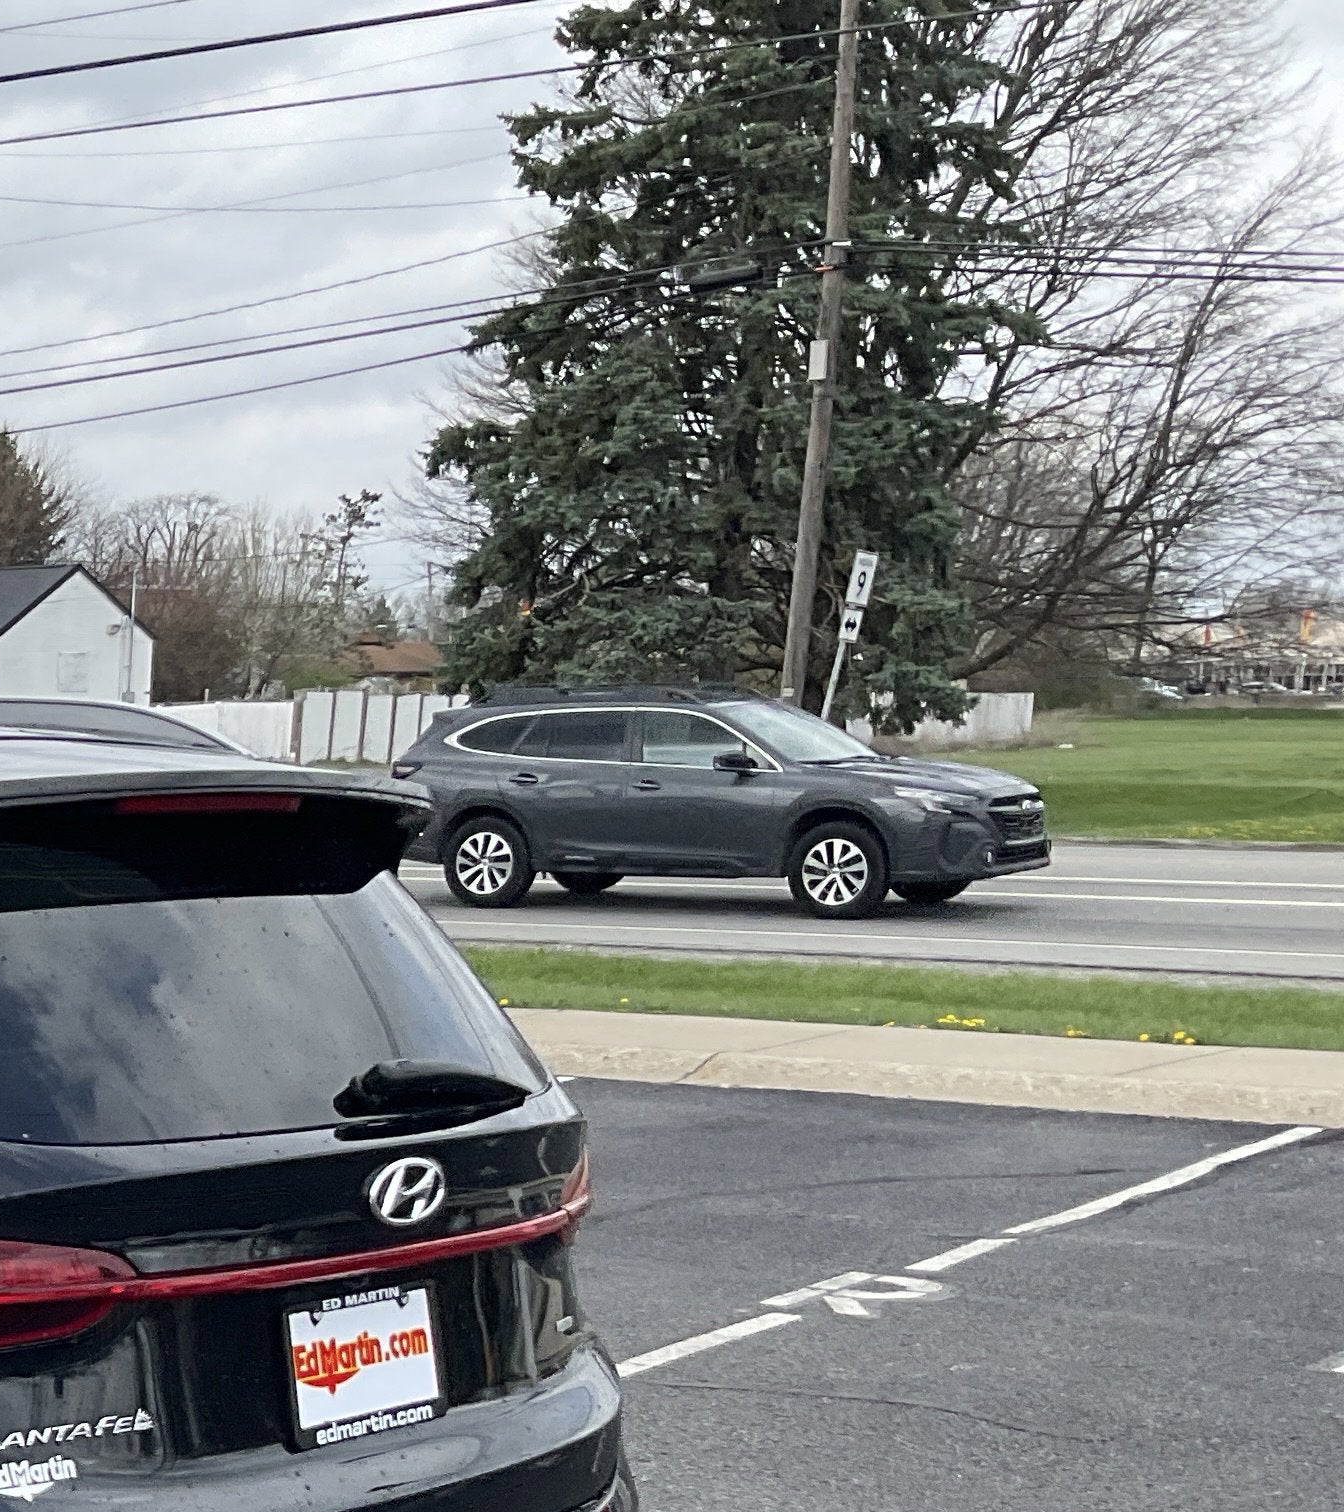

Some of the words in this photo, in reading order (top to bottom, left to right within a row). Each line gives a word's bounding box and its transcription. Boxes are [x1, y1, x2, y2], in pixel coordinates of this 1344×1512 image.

[856, 570, 867, 598] 9
[322, 1297, 342, 1311] ED
[344, 1286, 401, 1306] MARTIN
[291, 1327, 430, 1380] EdMartin.com
[316, 1404, 433, 1446] edmartin.com
